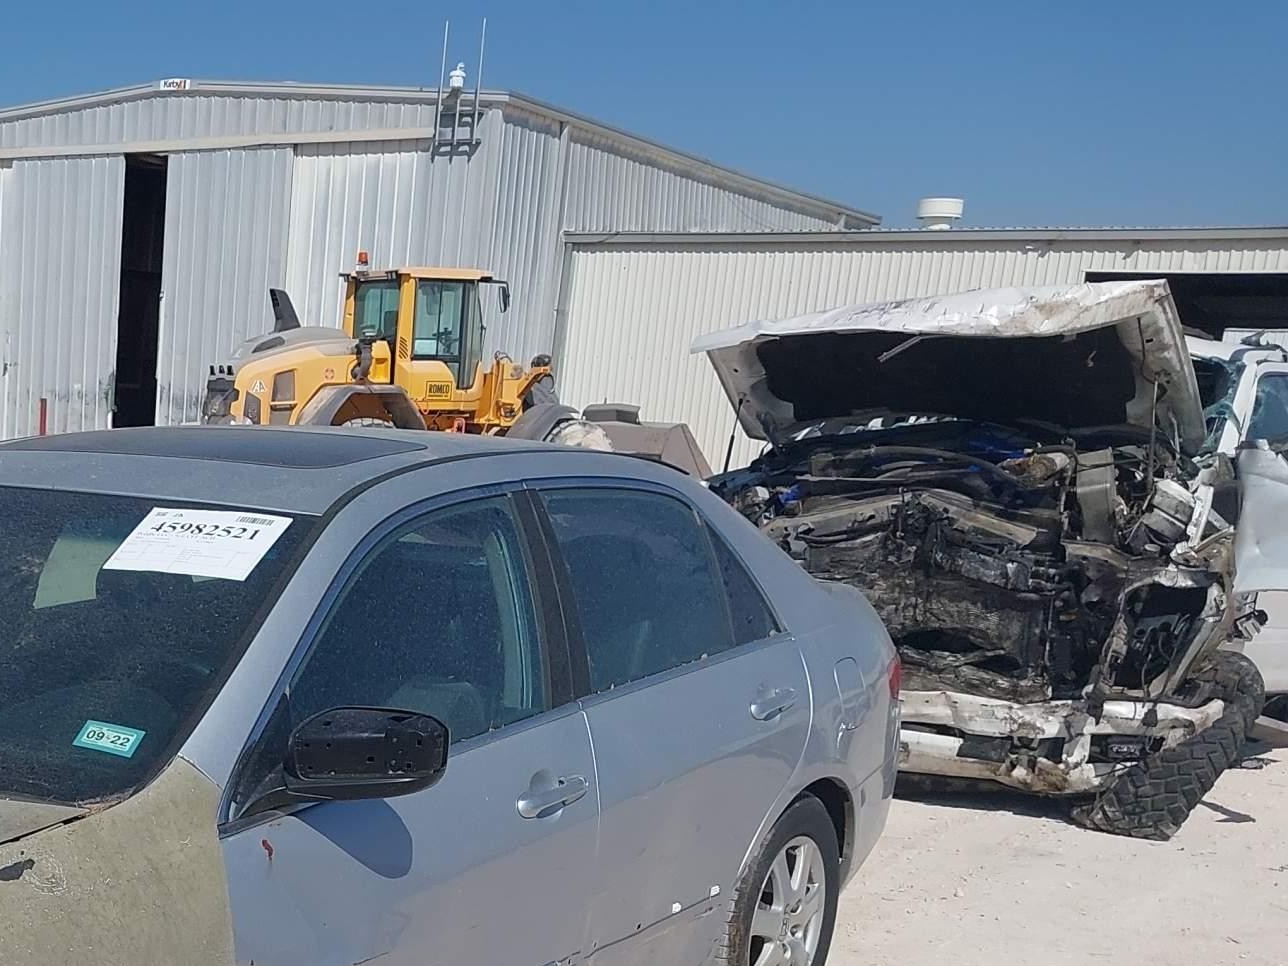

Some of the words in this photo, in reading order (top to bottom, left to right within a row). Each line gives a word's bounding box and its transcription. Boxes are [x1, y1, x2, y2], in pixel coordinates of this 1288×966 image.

[150, 521, 260, 541] 45982521
[86, 729, 105, 741] 09
[110, 734, 131, 747] 22
